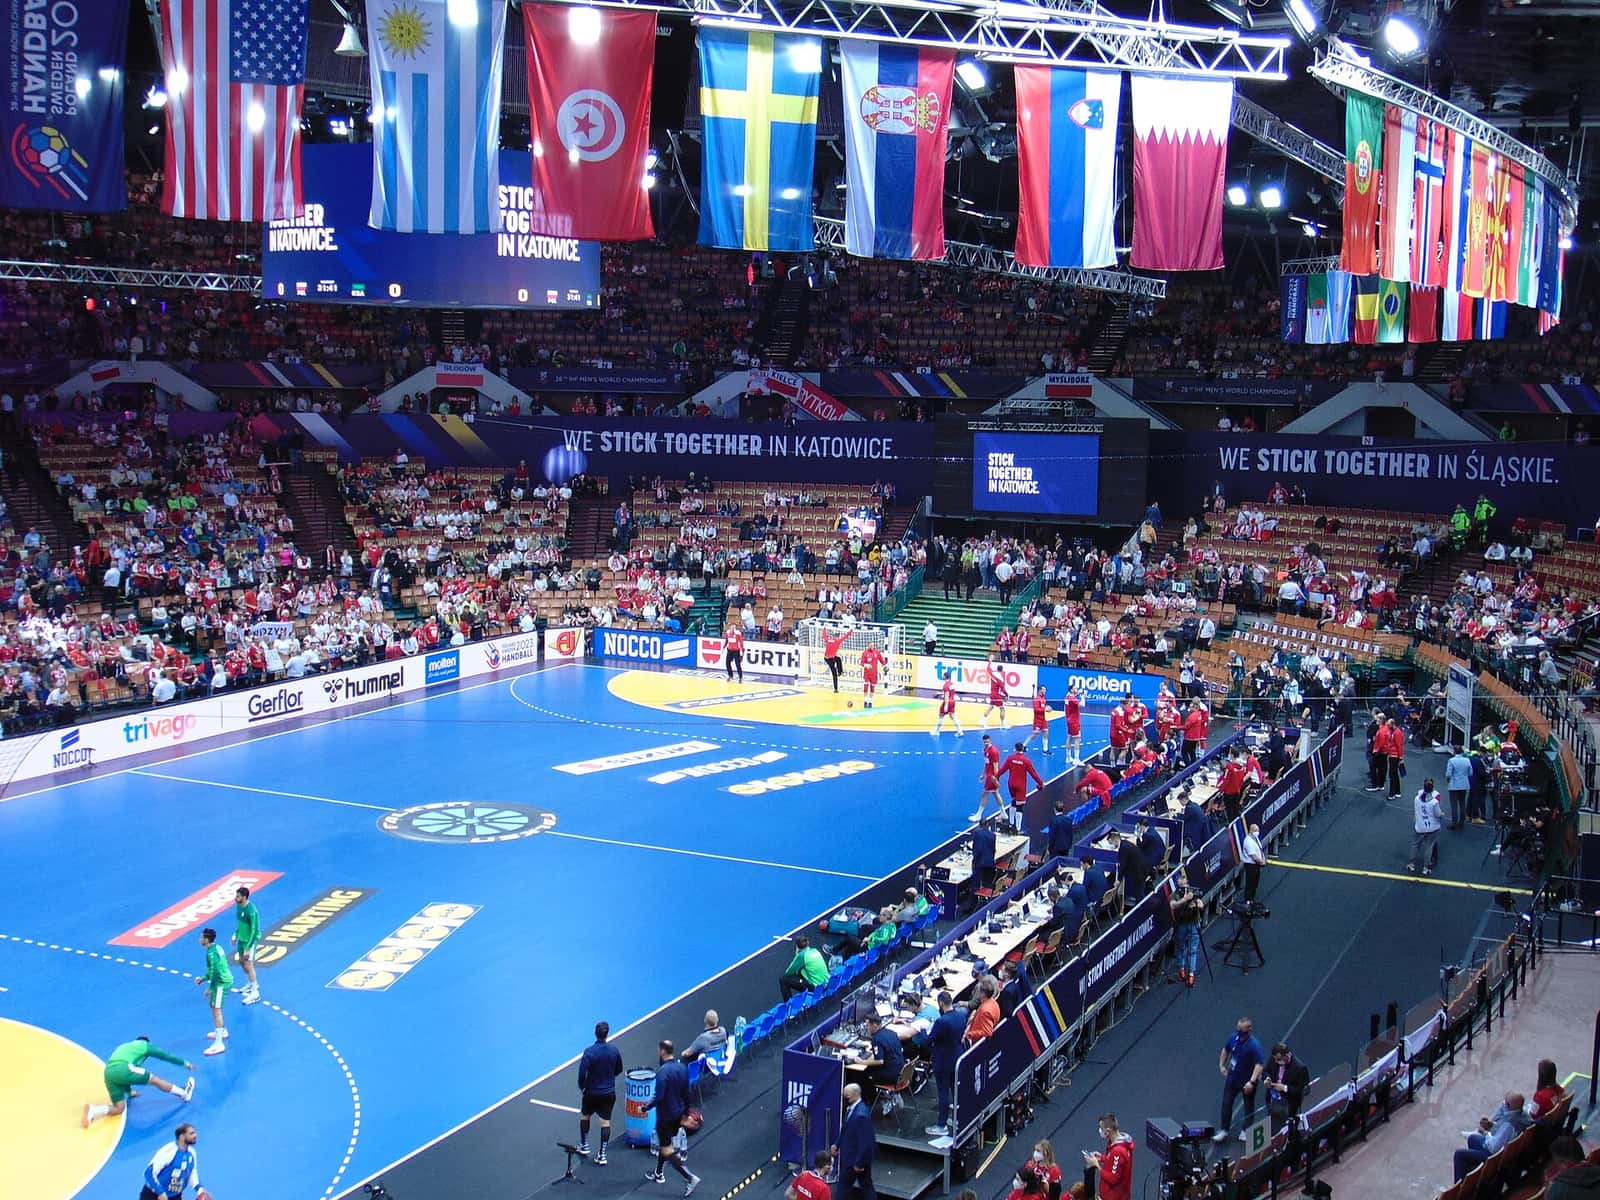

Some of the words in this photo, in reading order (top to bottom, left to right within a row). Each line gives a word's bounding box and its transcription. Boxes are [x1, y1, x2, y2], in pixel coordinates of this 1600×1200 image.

[497, 233, 515, 257] IN
[517, 234, 580, 262] KATOWICE.
[388, 283, 402, 298] 0
[563, 429, 593, 451] WE
[600, 430, 656, 453] STICK
[664, 432, 763, 456] TOGETHER
[769, 435, 788, 457] IN
[794, 436, 898, 460] KATOWICE.
[988, 453, 1014, 467] STICK
[1219, 447, 1250, 471] WE
[1256, 449, 1318, 474] STICK
[1324, 450, 1431, 478] TOGETHER
[1437, 456, 1457, 479] IN
[1464, 450, 1560, 487] ŚLĄSKIE.
[988, 466, 1033, 481] TOGETHER
[988, 480, 997, 494] IN
[998, 480, 1040, 495] KATOWICE.
[501, 648, 534, 664] HANDBALL
[603, 631, 661, 659] NOCCO
[746, 648, 799, 668] ÜRTH
[428, 656, 457, 673] molten
[934, 661, 1021, 689] trivao
[344, 666, 405, 700] hummel
[1068, 675, 1131, 693] molten
[248, 688, 304, 719] Gerflor
[123, 712, 197, 744] trivago
[1252, 1125, 1265, 1151] B
